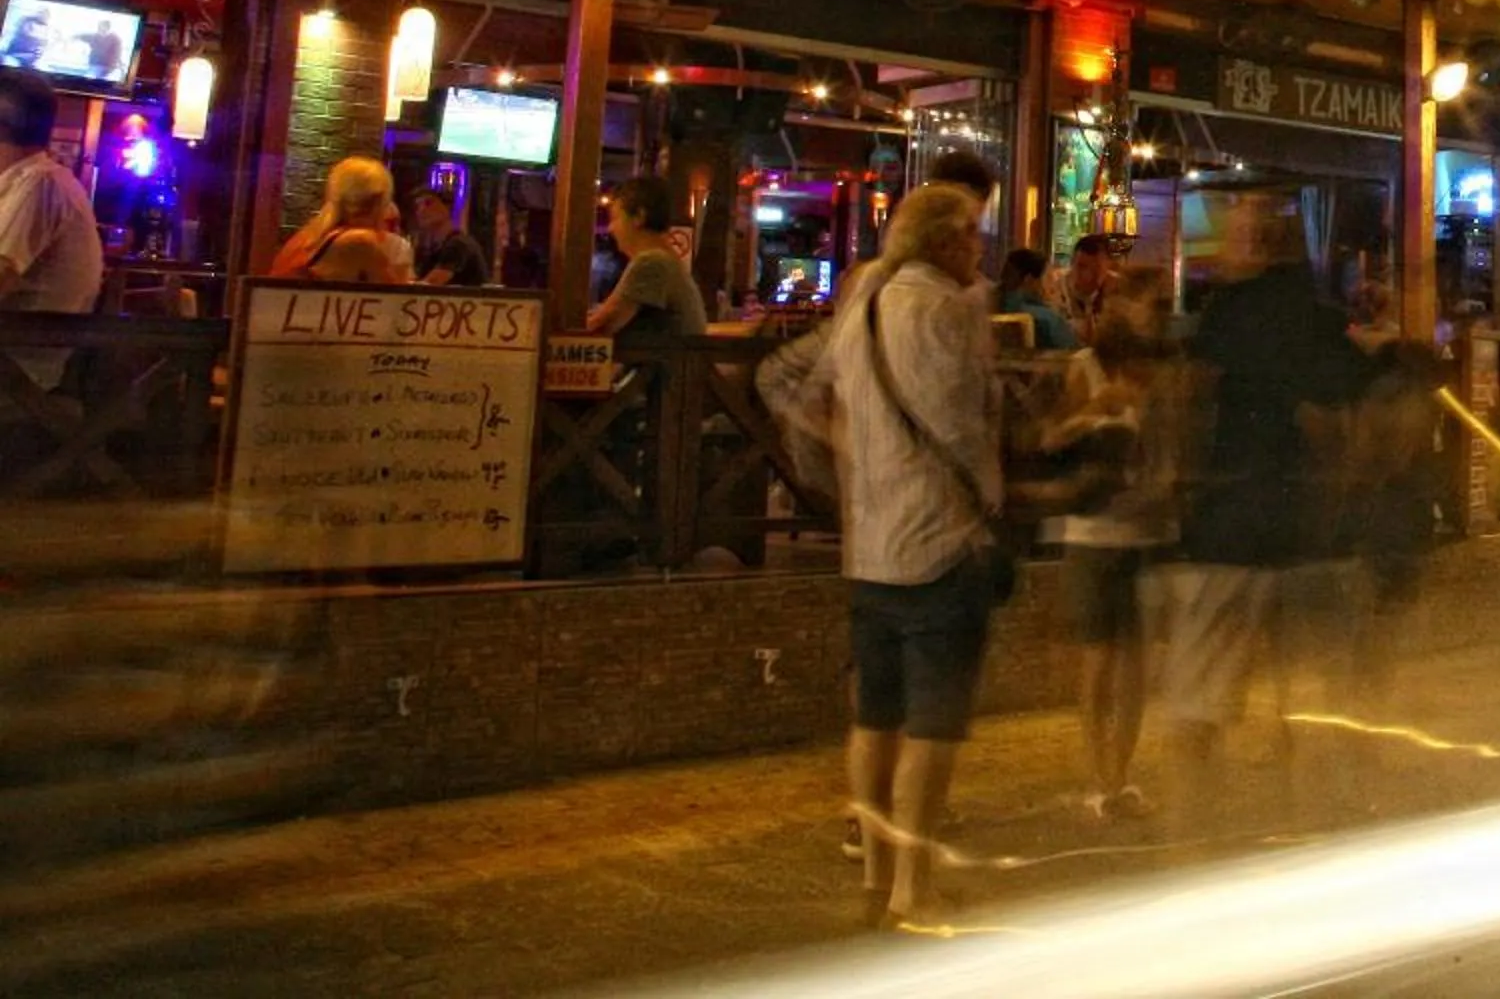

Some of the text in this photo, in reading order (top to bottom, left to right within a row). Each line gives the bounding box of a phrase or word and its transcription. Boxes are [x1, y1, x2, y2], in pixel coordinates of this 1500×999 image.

[281, 293, 524, 343] LIVE SPORTS
[370, 352, 431, 370] TODAY
[547, 344, 609, 363] AMES
